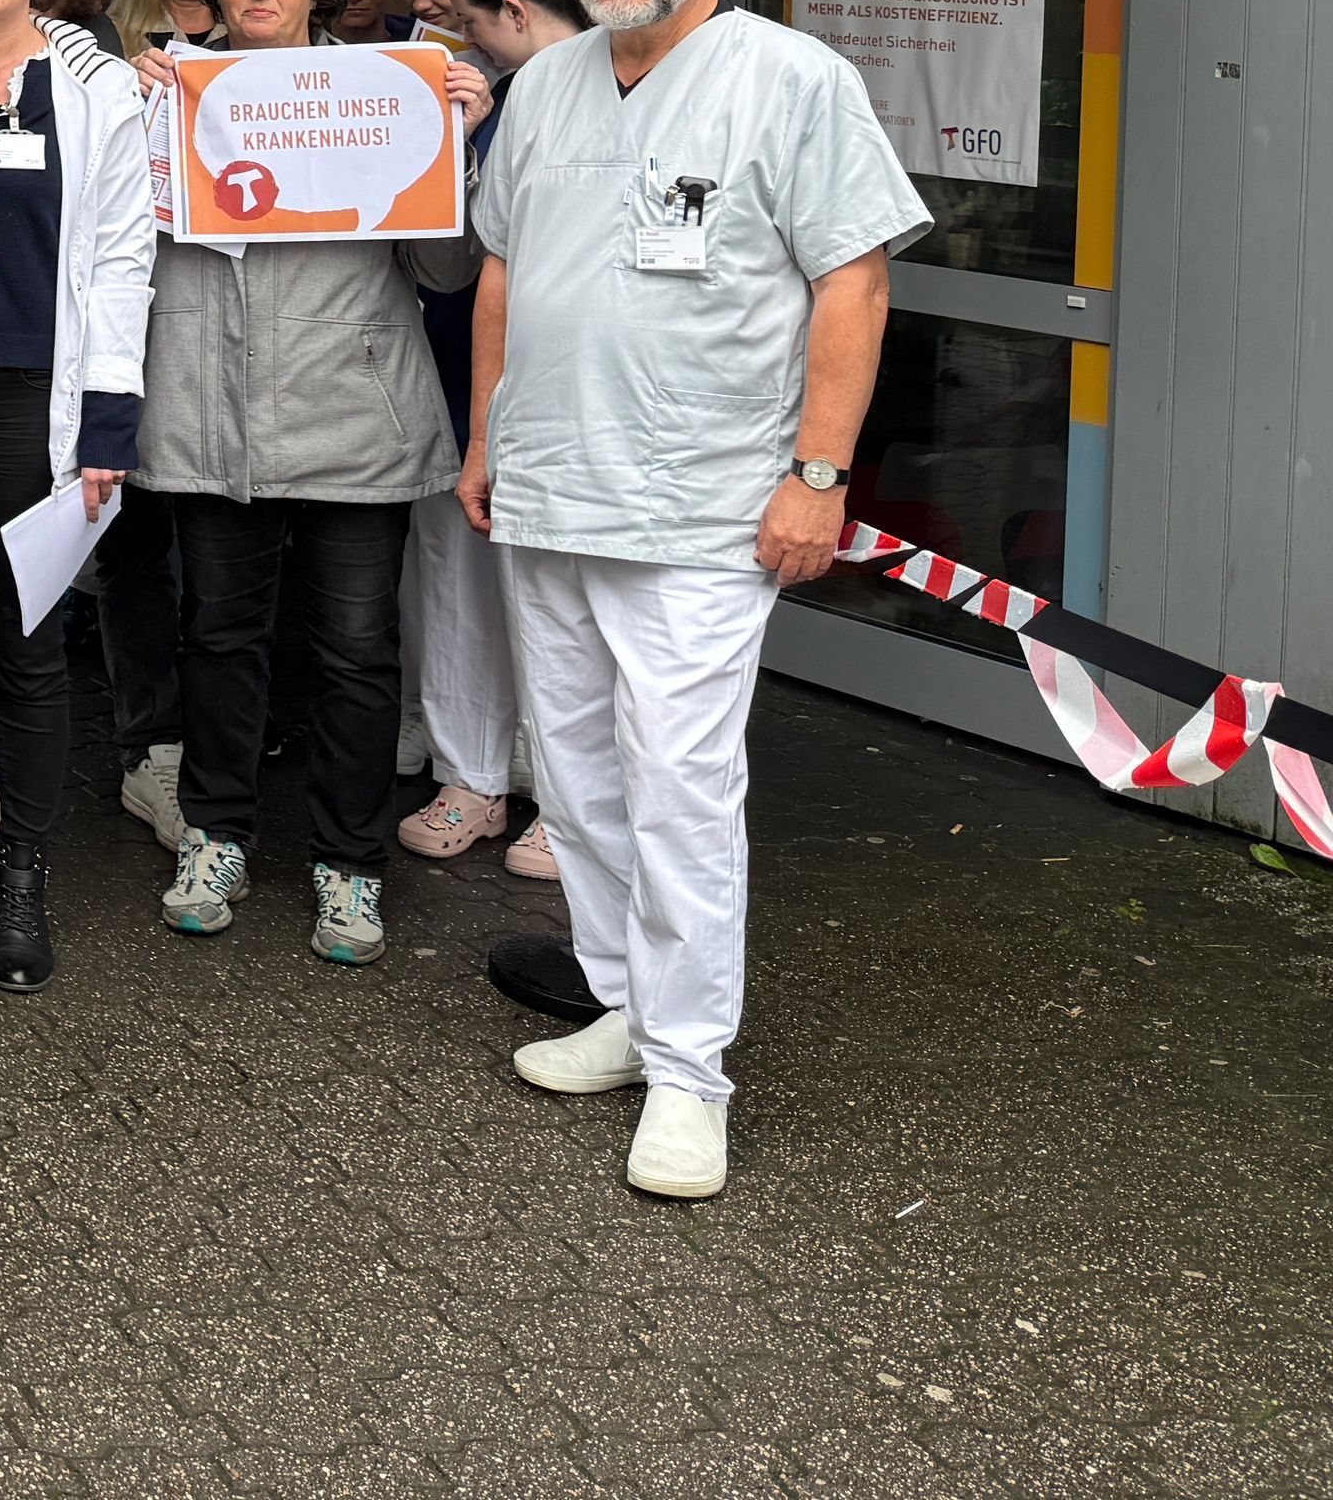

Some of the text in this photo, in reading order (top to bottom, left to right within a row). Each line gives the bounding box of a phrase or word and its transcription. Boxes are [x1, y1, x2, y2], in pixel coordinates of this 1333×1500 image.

[807, 3, 1004, 26] MEHR ALS KOSTENEFFIZIENZ.
[829, 31, 883, 48] bedeutet
[886, 35, 956, 53] Sicherheit
[292, 71, 332, 91] WIR
[229, 97, 401, 123] BRAUCHEN UNSER
[243, 127, 391, 151] KRANKENHAUS!
[962, 127, 1002, 156] GFO
